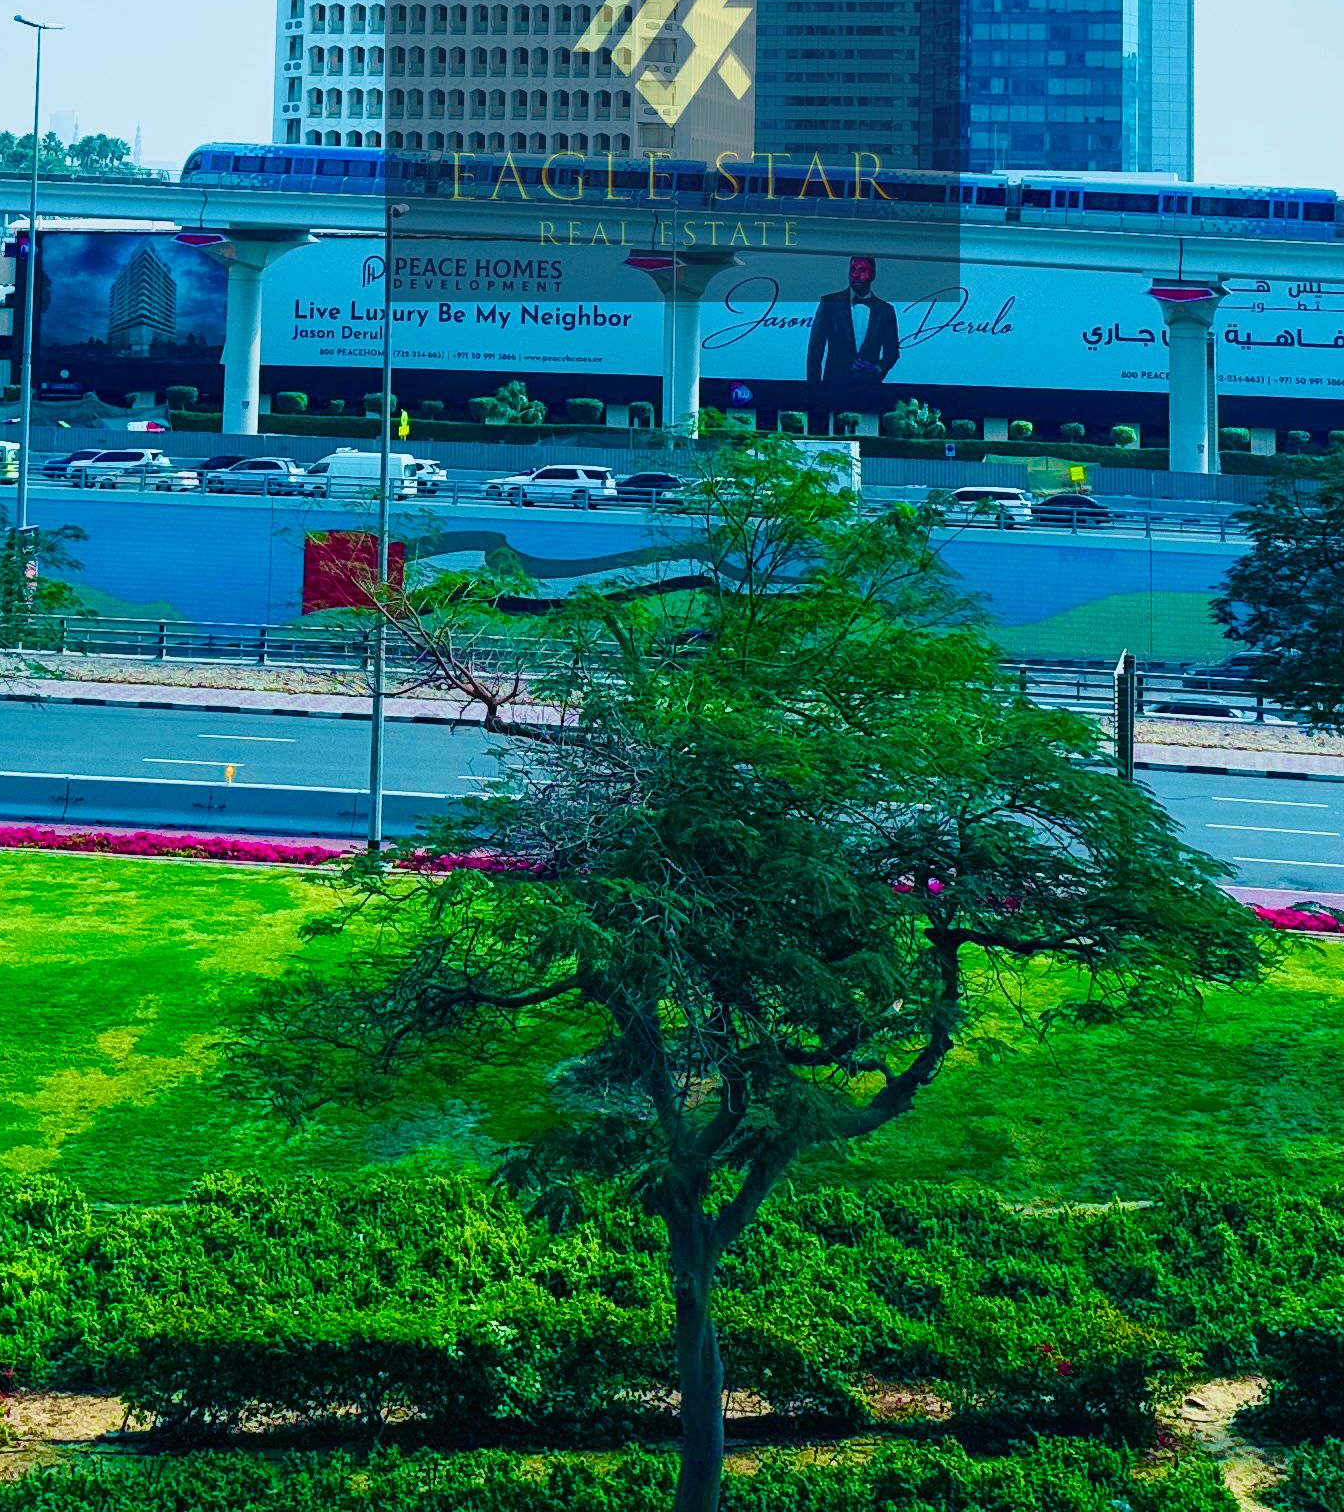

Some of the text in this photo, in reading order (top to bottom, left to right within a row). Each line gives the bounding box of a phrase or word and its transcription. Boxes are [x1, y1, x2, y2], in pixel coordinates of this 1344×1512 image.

[394, 257, 563, 280] PEACE HOMES
[393, 278, 563, 293] DEVELOPMENT
[294, 299, 341, 320] Live
[438, 302, 466, 323] Be
[476, 303, 511, 329] My
[521, 303, 632, 331] Neighbor
[292, 324, 391, 340] Jason Derul
